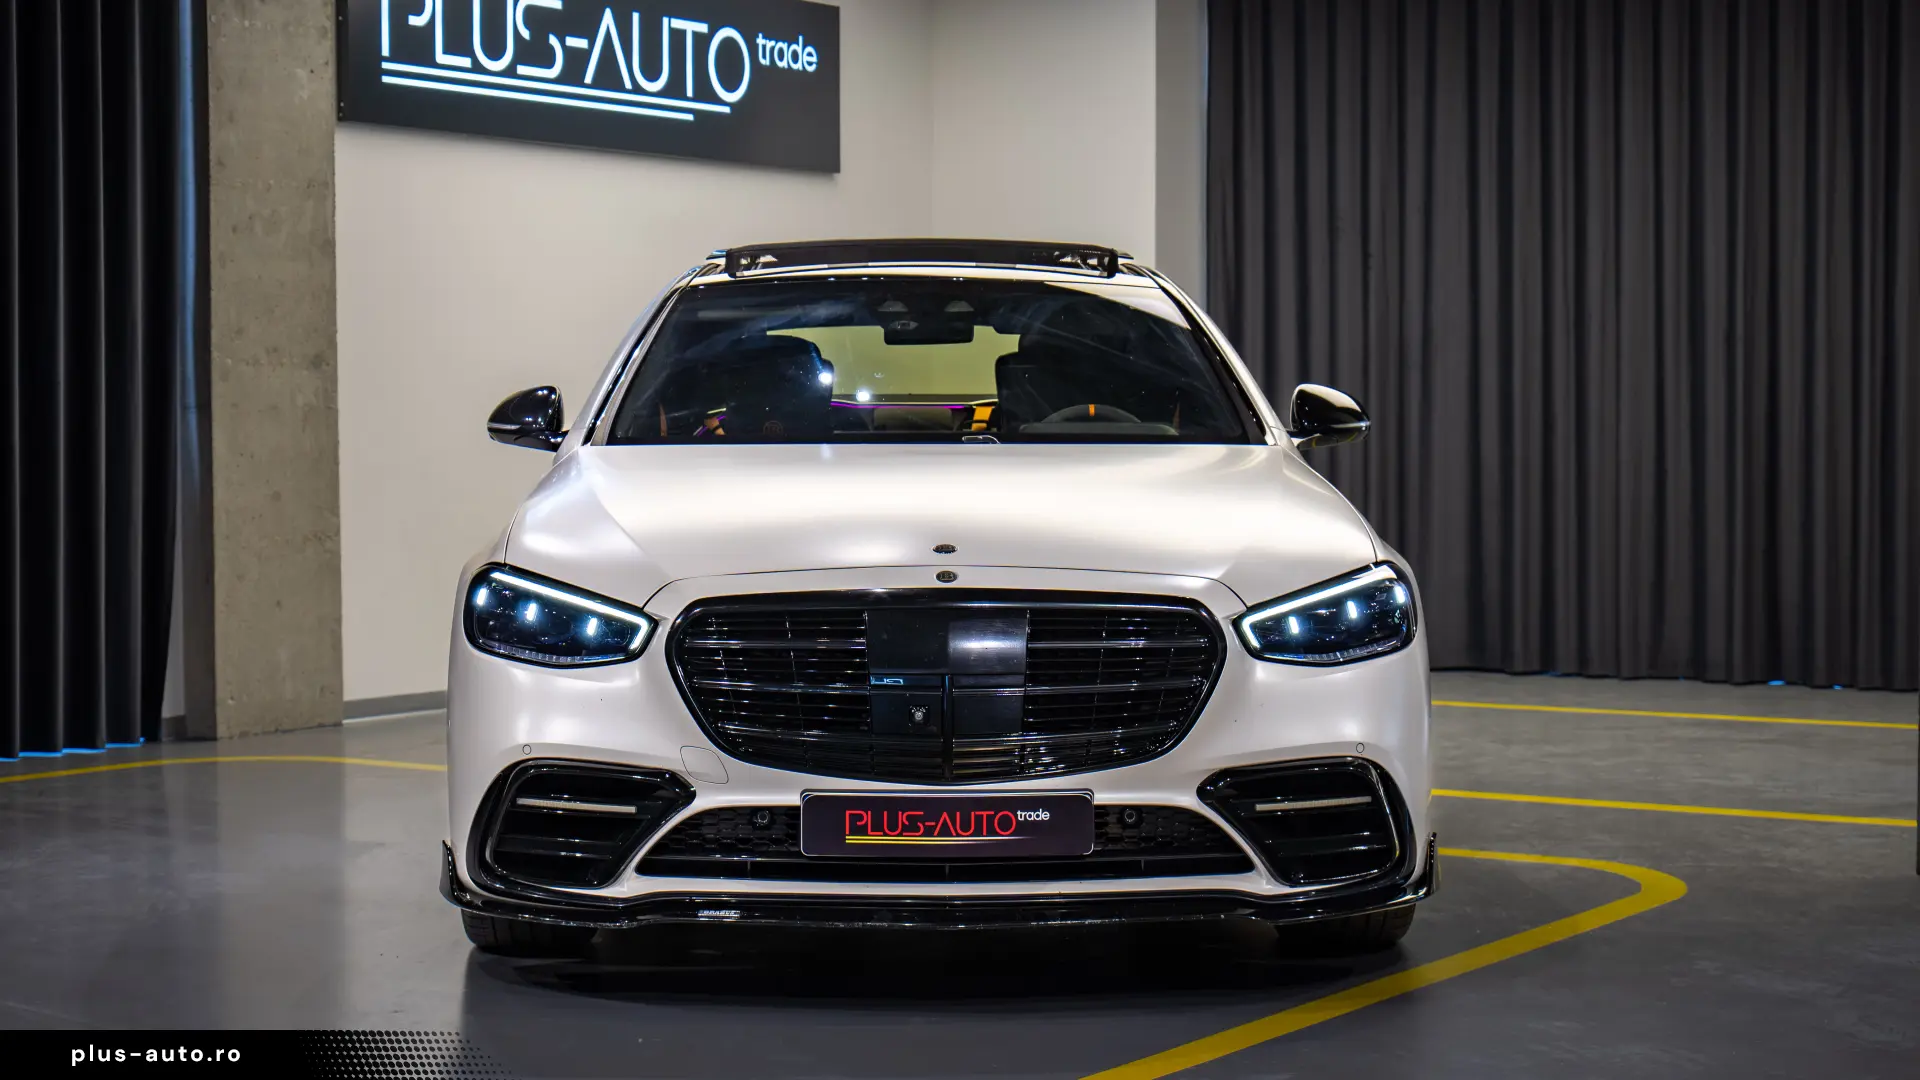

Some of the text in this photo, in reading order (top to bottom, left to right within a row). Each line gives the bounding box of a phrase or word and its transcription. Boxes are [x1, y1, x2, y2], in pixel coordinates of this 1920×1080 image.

[380, 0, 818, 102] PLUS-AUTO trade
[845, 808, 1050, 836] PLUS-AUTO trade
